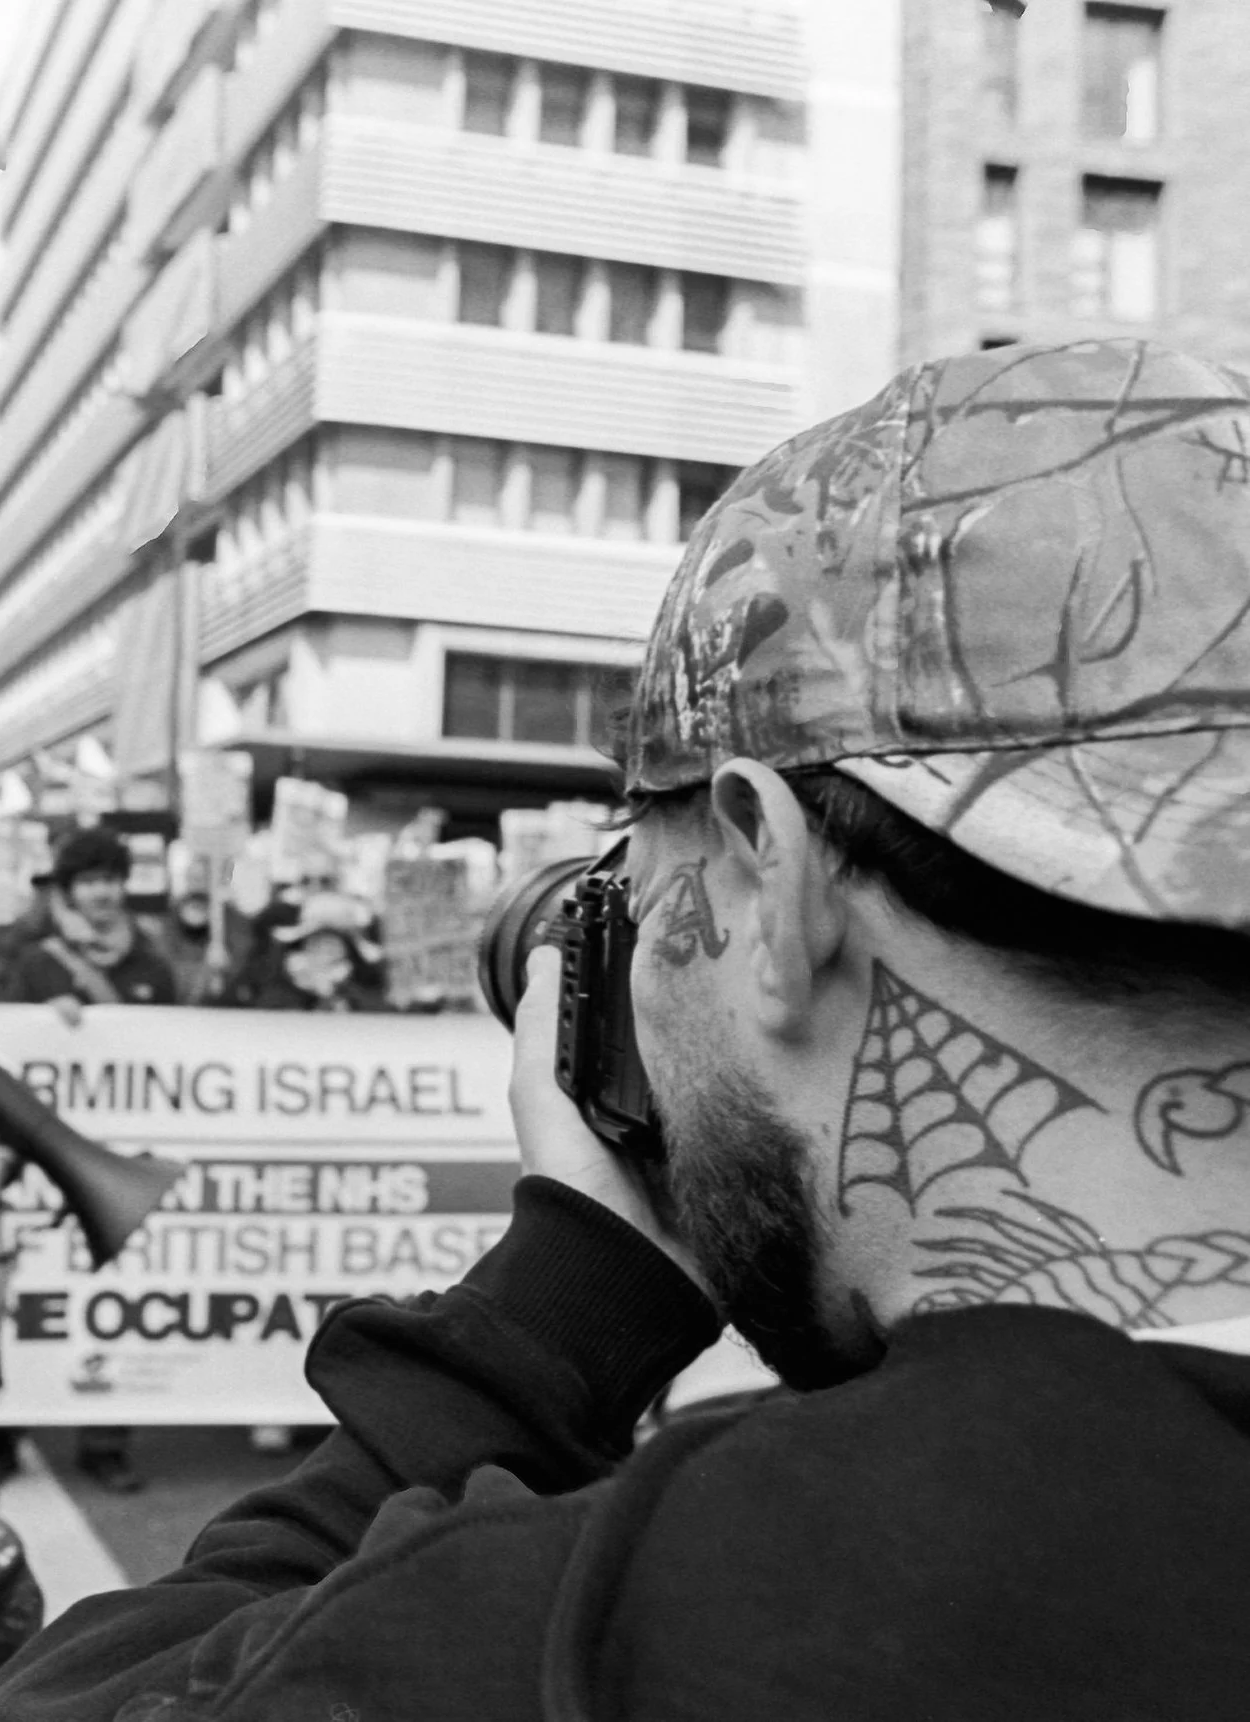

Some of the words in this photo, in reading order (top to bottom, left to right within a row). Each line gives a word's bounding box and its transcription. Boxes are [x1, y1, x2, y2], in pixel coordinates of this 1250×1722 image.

[256, 1065, 485, 1117] ISRAEL
[207, 1163, 312, 1212] THE
[316, 1164, 429, 1212] NHS
